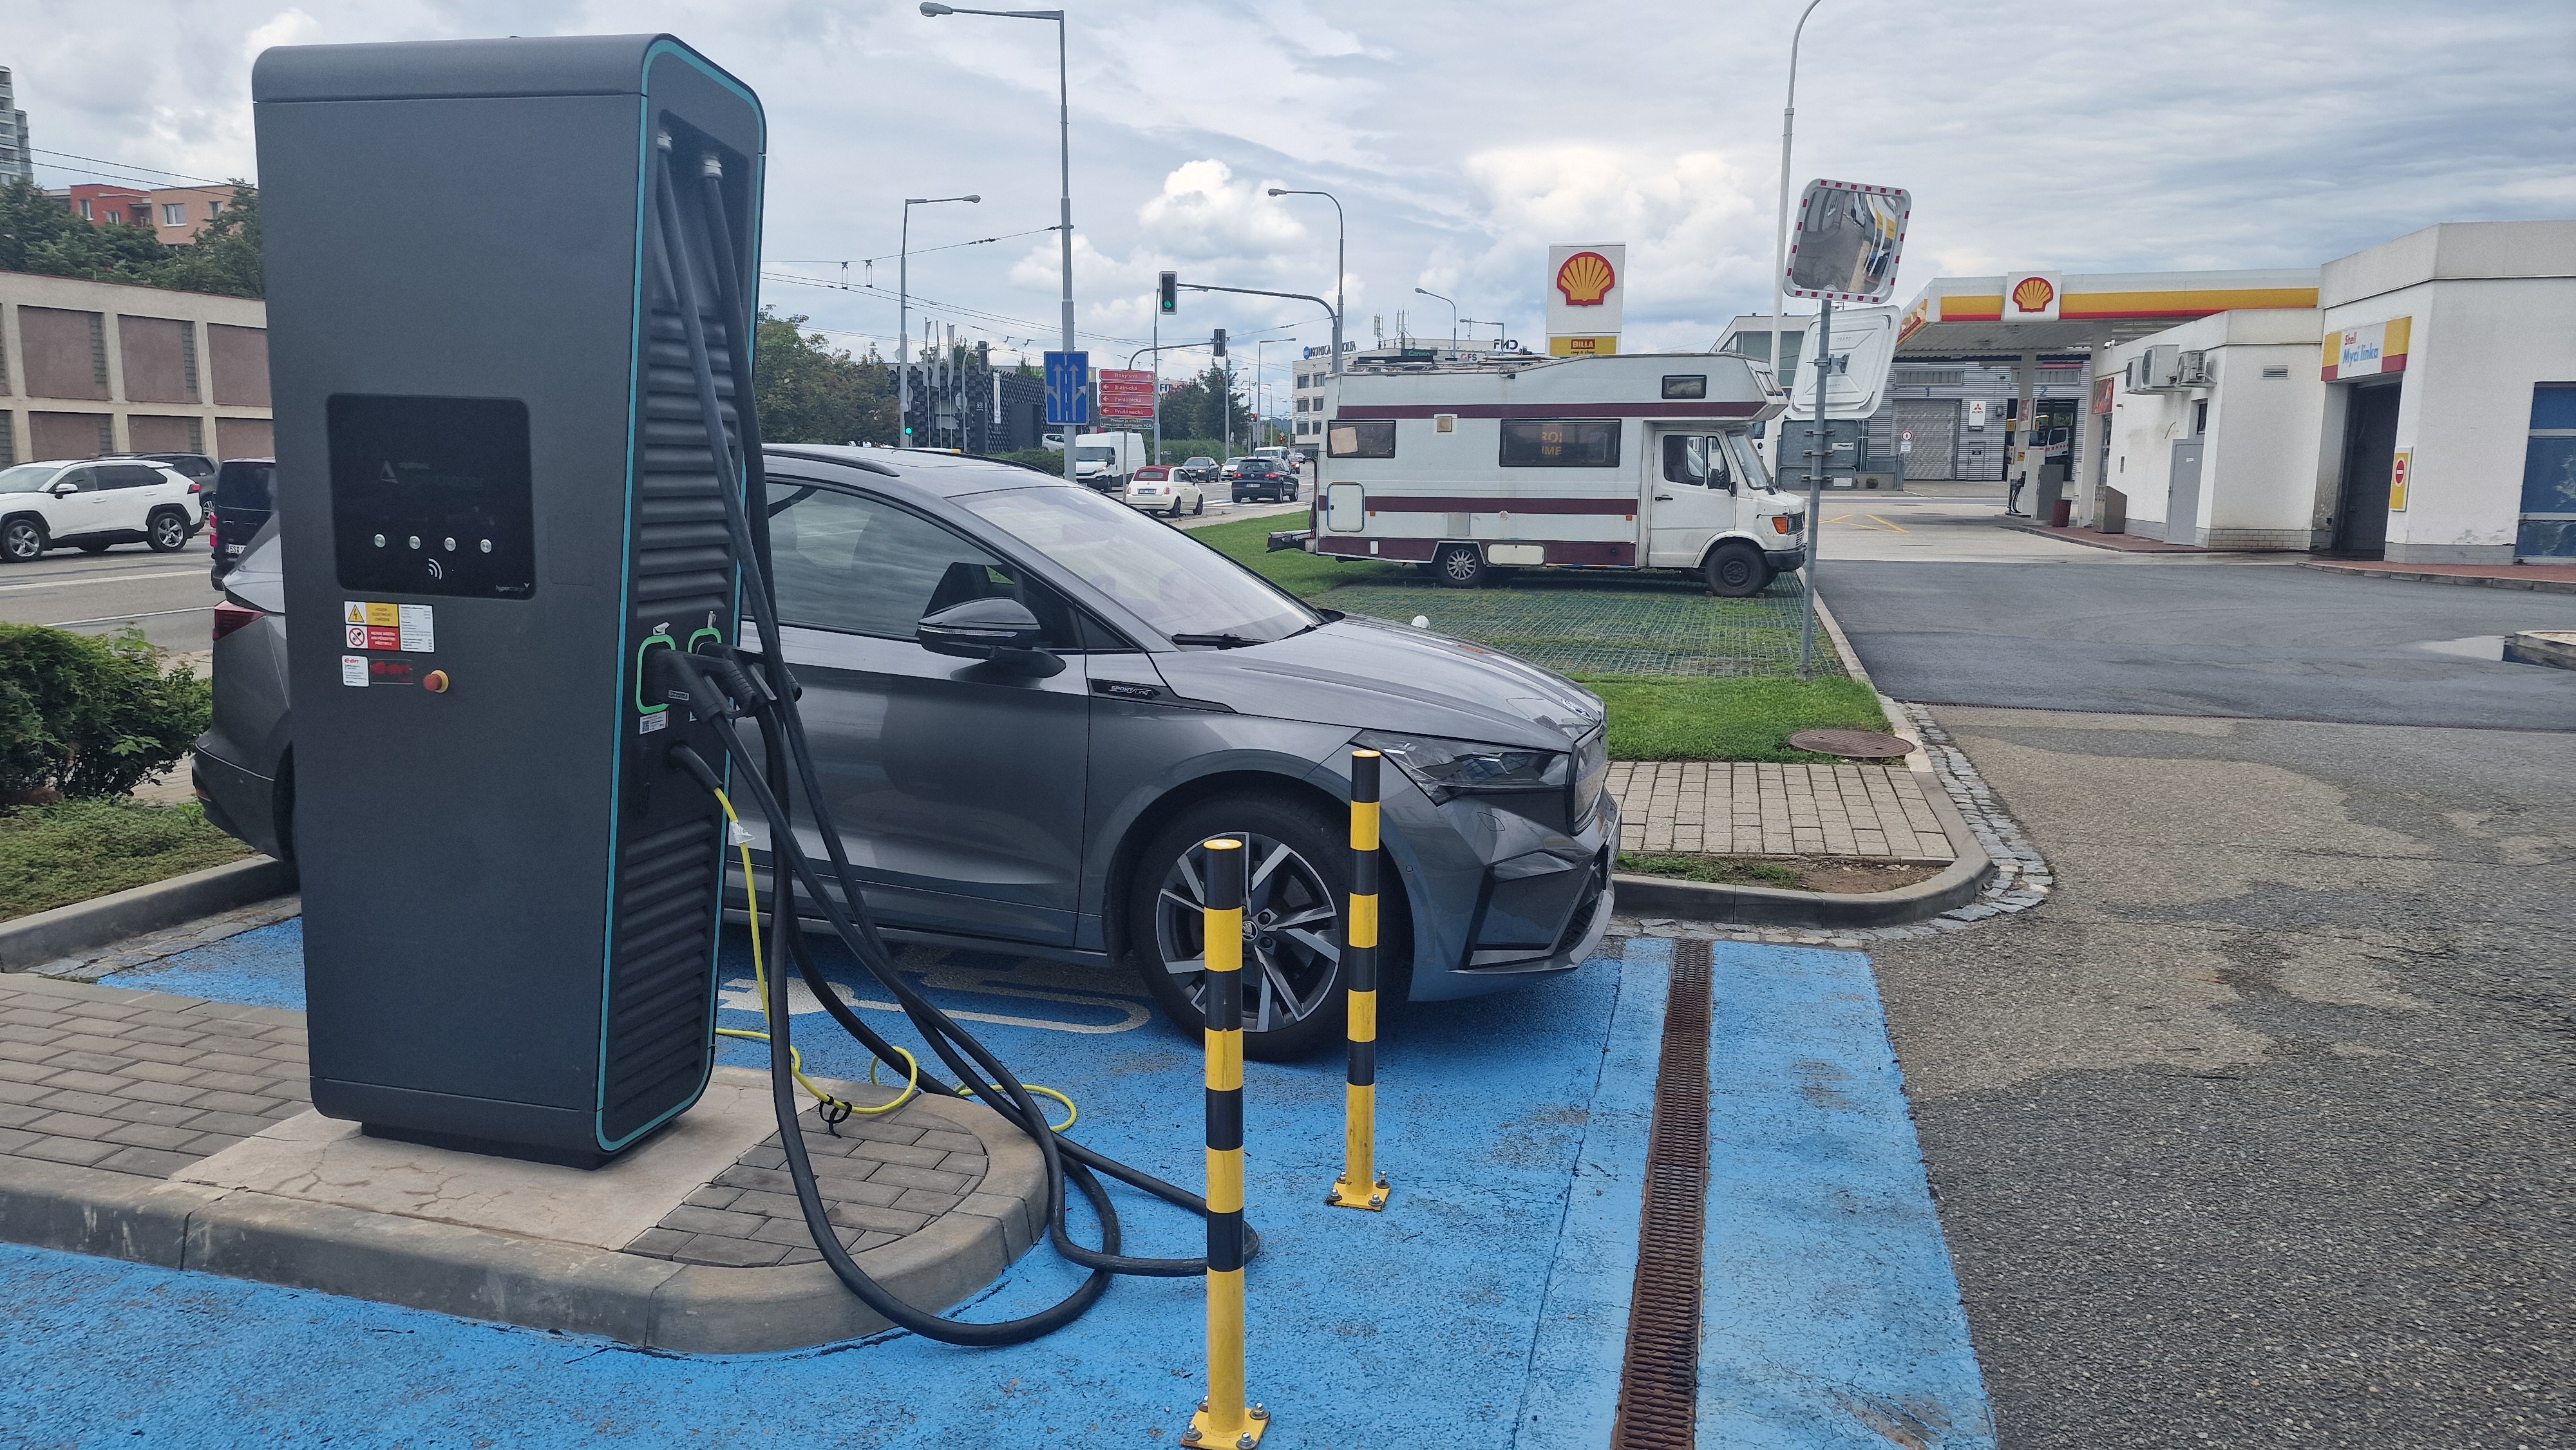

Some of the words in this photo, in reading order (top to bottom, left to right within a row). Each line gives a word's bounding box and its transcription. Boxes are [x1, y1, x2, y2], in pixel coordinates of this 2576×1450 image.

[2345, 332, 2357, 346] Shell
[1310, 344, 1331, 357] KONICA
[2343, 346, 2360, 368] Mycí
[2360, 343, 2379, 361] linka
[2039, 386, 2047, 397] 2
